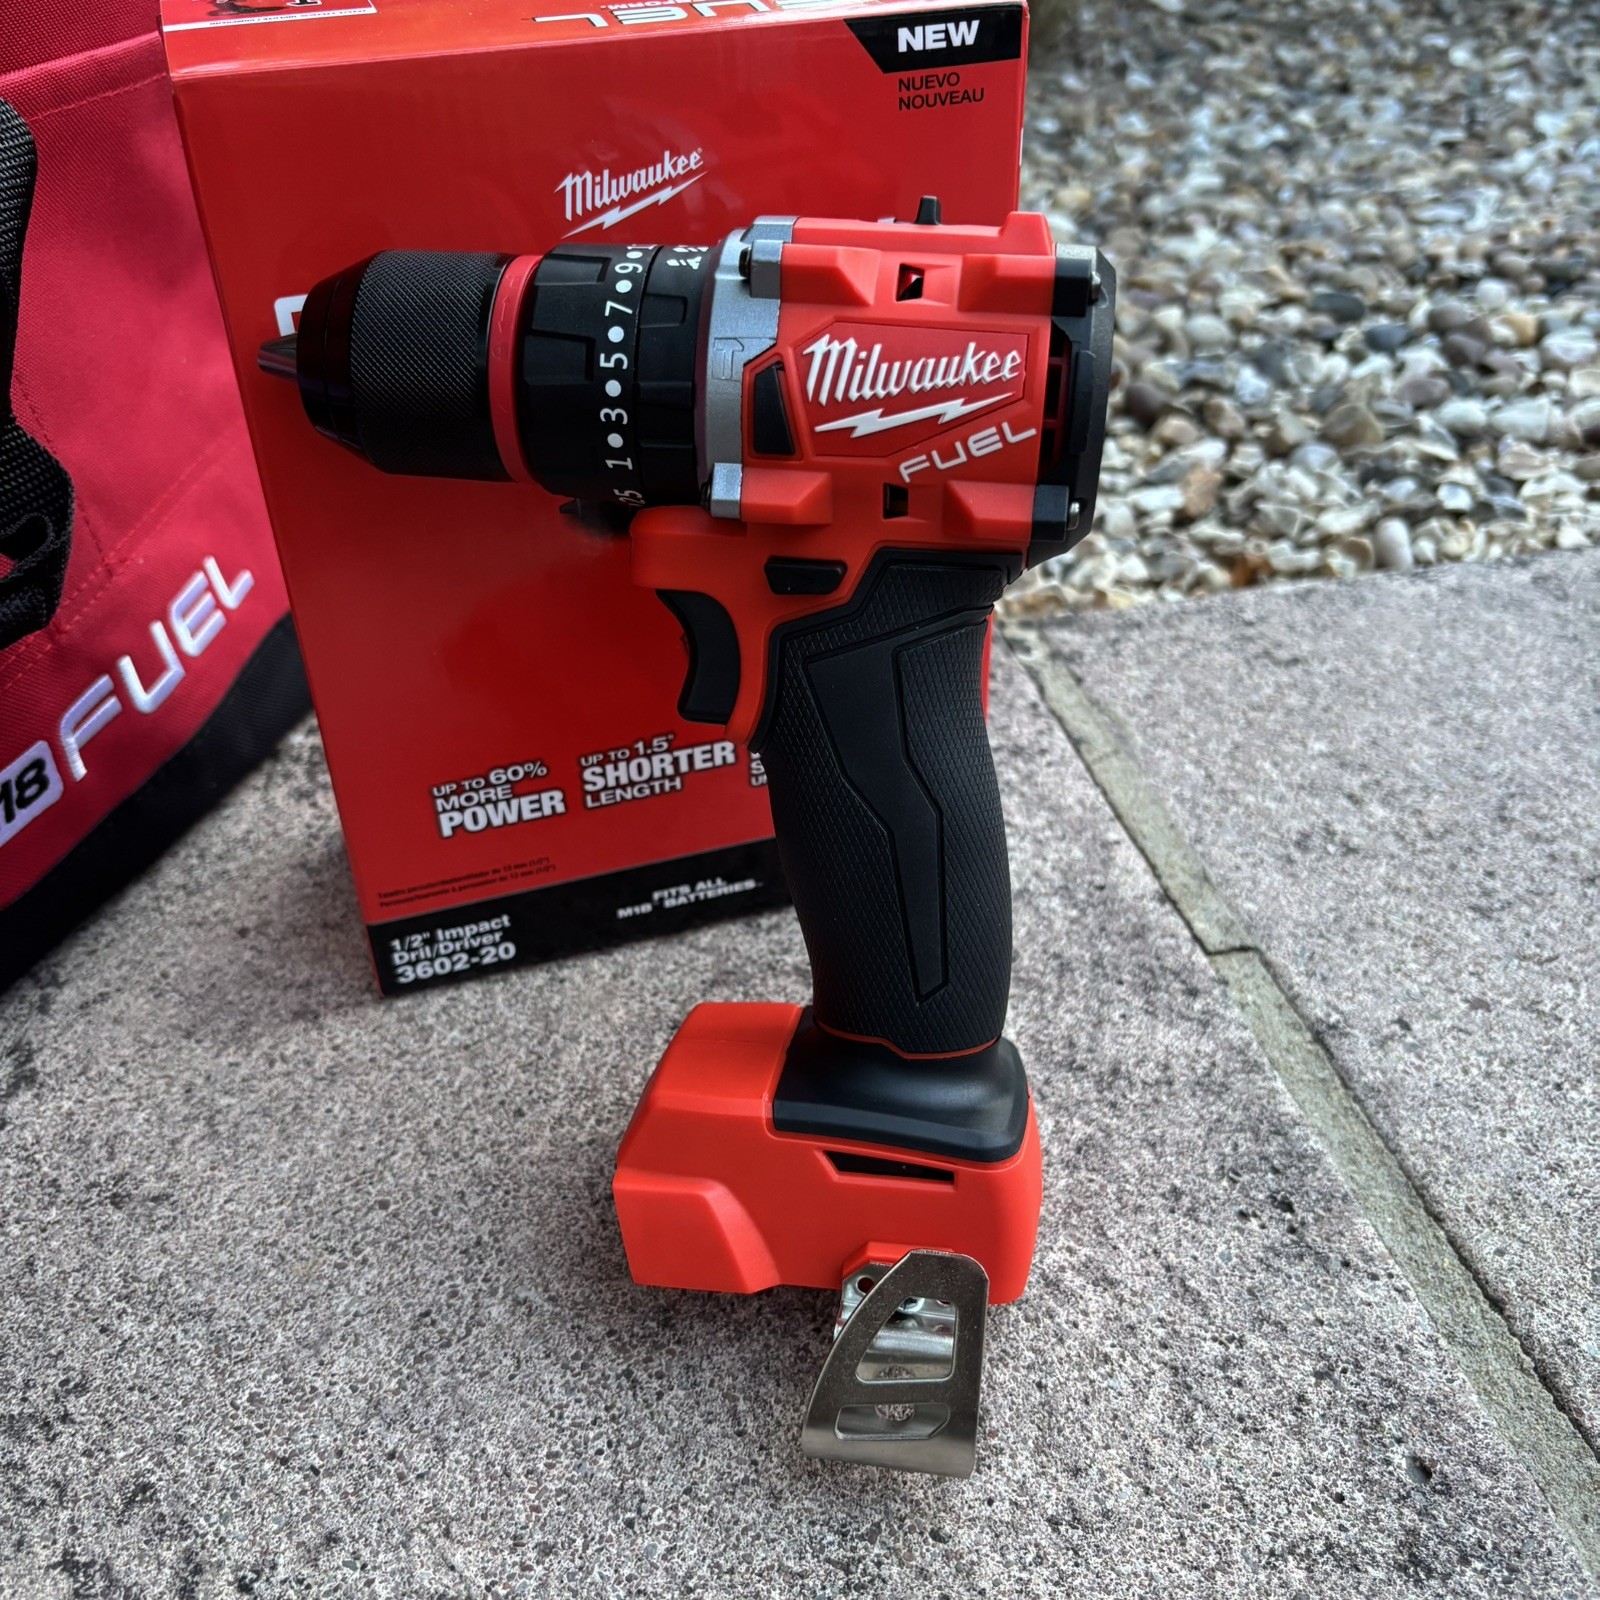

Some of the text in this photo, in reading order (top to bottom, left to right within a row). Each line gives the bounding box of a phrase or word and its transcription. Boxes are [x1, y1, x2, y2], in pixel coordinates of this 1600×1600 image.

[897, 20, 980, 53] NEW
[898, 72, 961, 93] NUEVO
[898, 88, 984, 111] NOUVEAU
[553, 149, 704, 222] Milwaukee
[615, 263, 642, 273] 9
[605, 300, 633, 317] 7
[600, 353, 628, 370] 5
[802, 333, 1022, 407] Milwaukee
[600, 408, 628, 425] 3
[605, 457, 633, 471] 1
[899, 421, 1037, 484] FUEL
[60, 555, 254, 783] FUEL
[580, 753, 604, 767] UP
[607, 748, 631, 761] TO
[582, 741, 736, 792] SHORTER
[432, 761, 547, 797] UP TO 60%
[585, 777, 682, 808] LENGTH
[436, 785, 513, 812] MORE
[439, 790, 566, 838] POWER
[652, 876, 727, 902] FITS ALL
[663, 879, 757, 909] BATTERIES
[436, 914, 511, 941] Impact
[395, 941, 517, 984] 3602-20
